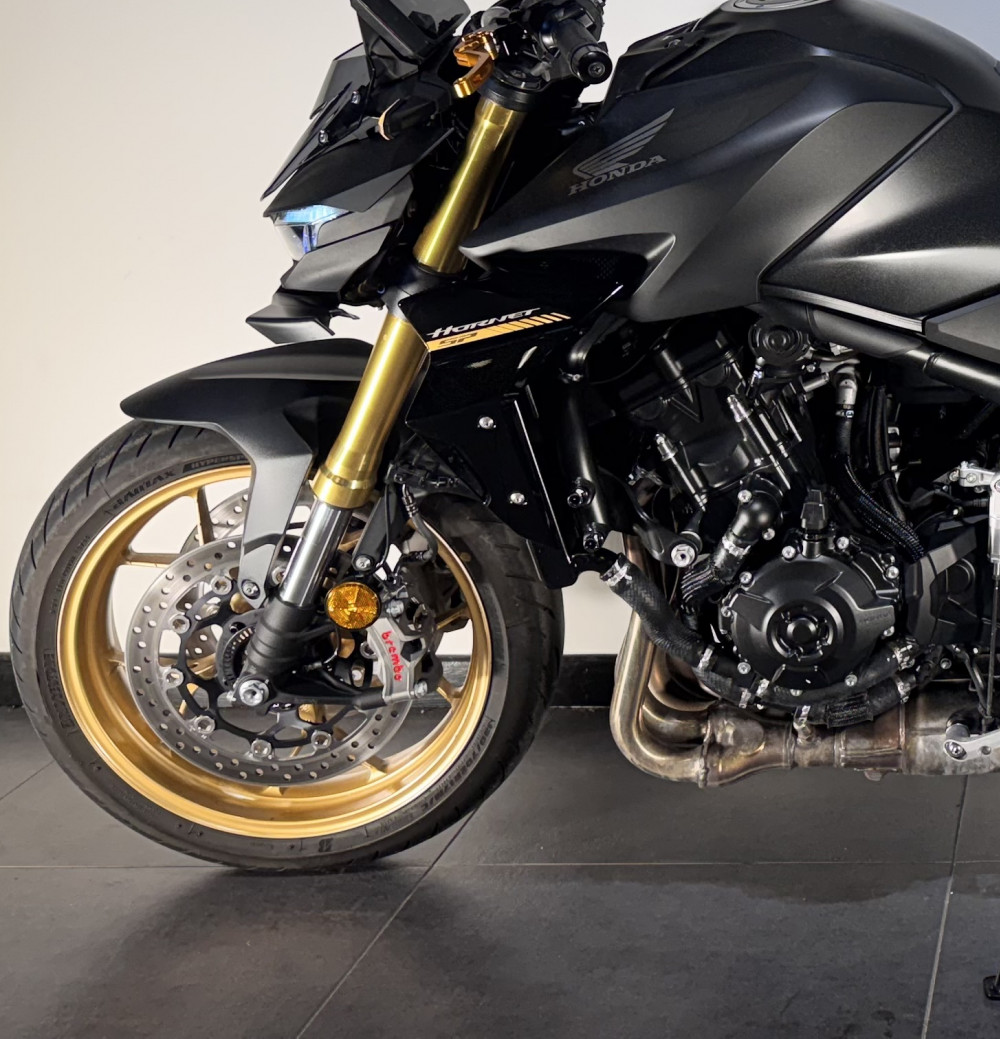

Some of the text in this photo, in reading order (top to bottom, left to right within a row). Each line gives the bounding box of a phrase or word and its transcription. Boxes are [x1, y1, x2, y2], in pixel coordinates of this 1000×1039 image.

[567, 154, 667, 196] HONDA
[426, 307, 541, 339] HORNET
[381, 629, 405, 682] brembo
